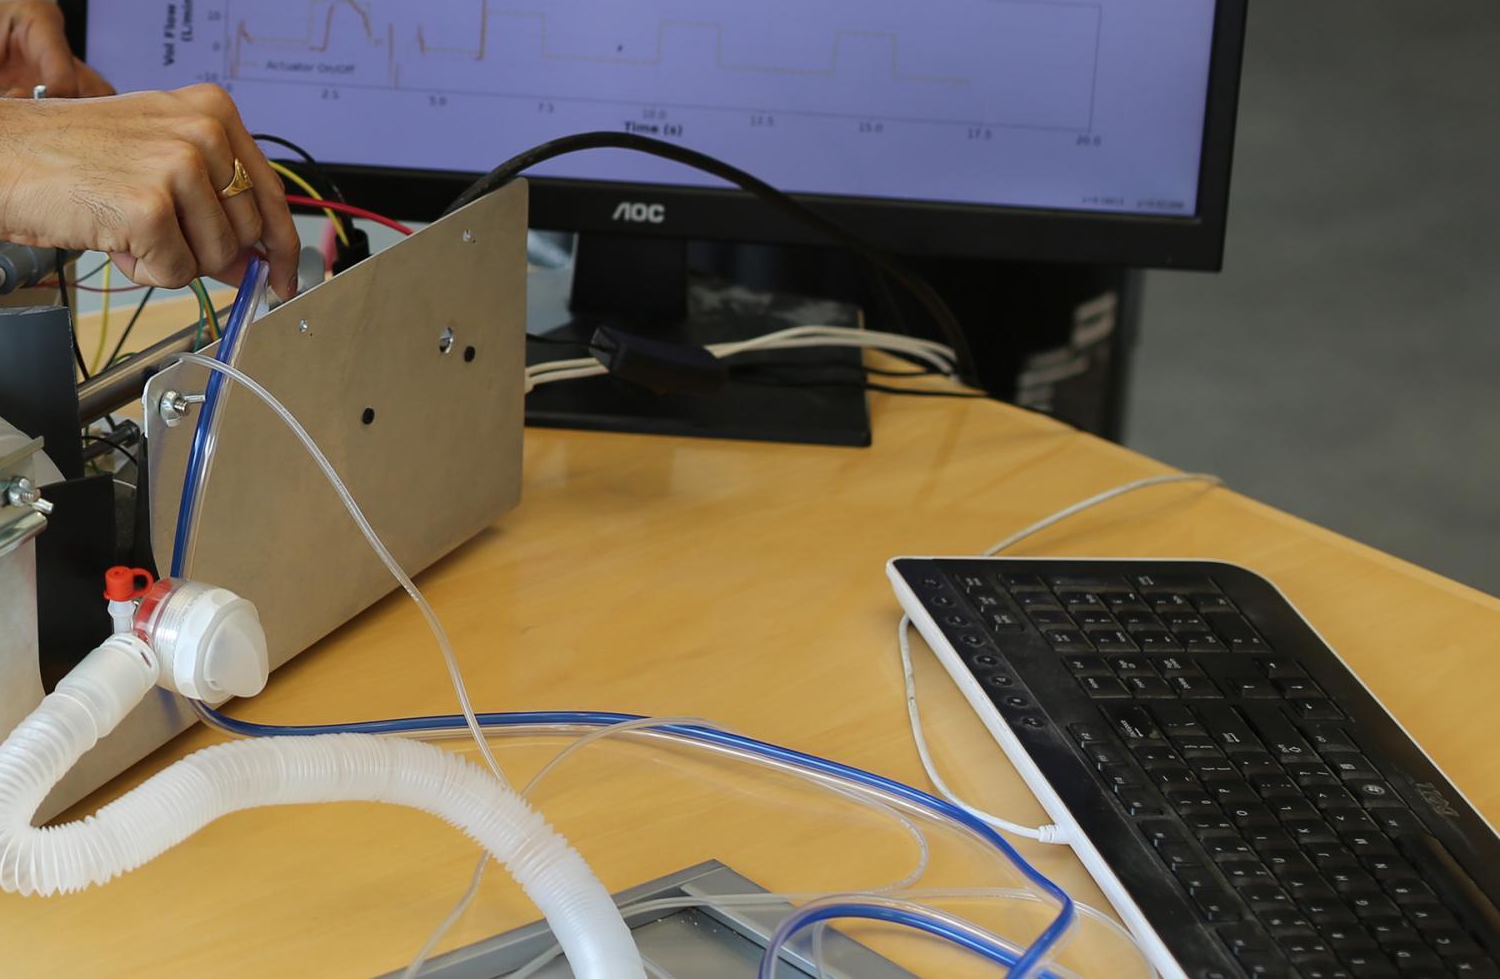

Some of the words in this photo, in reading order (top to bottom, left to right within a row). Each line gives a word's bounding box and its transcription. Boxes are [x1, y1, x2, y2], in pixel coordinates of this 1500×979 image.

[163, 3, 177, 39] Flow
[161, 42, 176, 66] Vol
[265, 59, 316, 72] Actuator
[624, 119, 661, 134] Time
[664, 122, 684, 138] (s)
[611, 202, 665, 223] AOC
